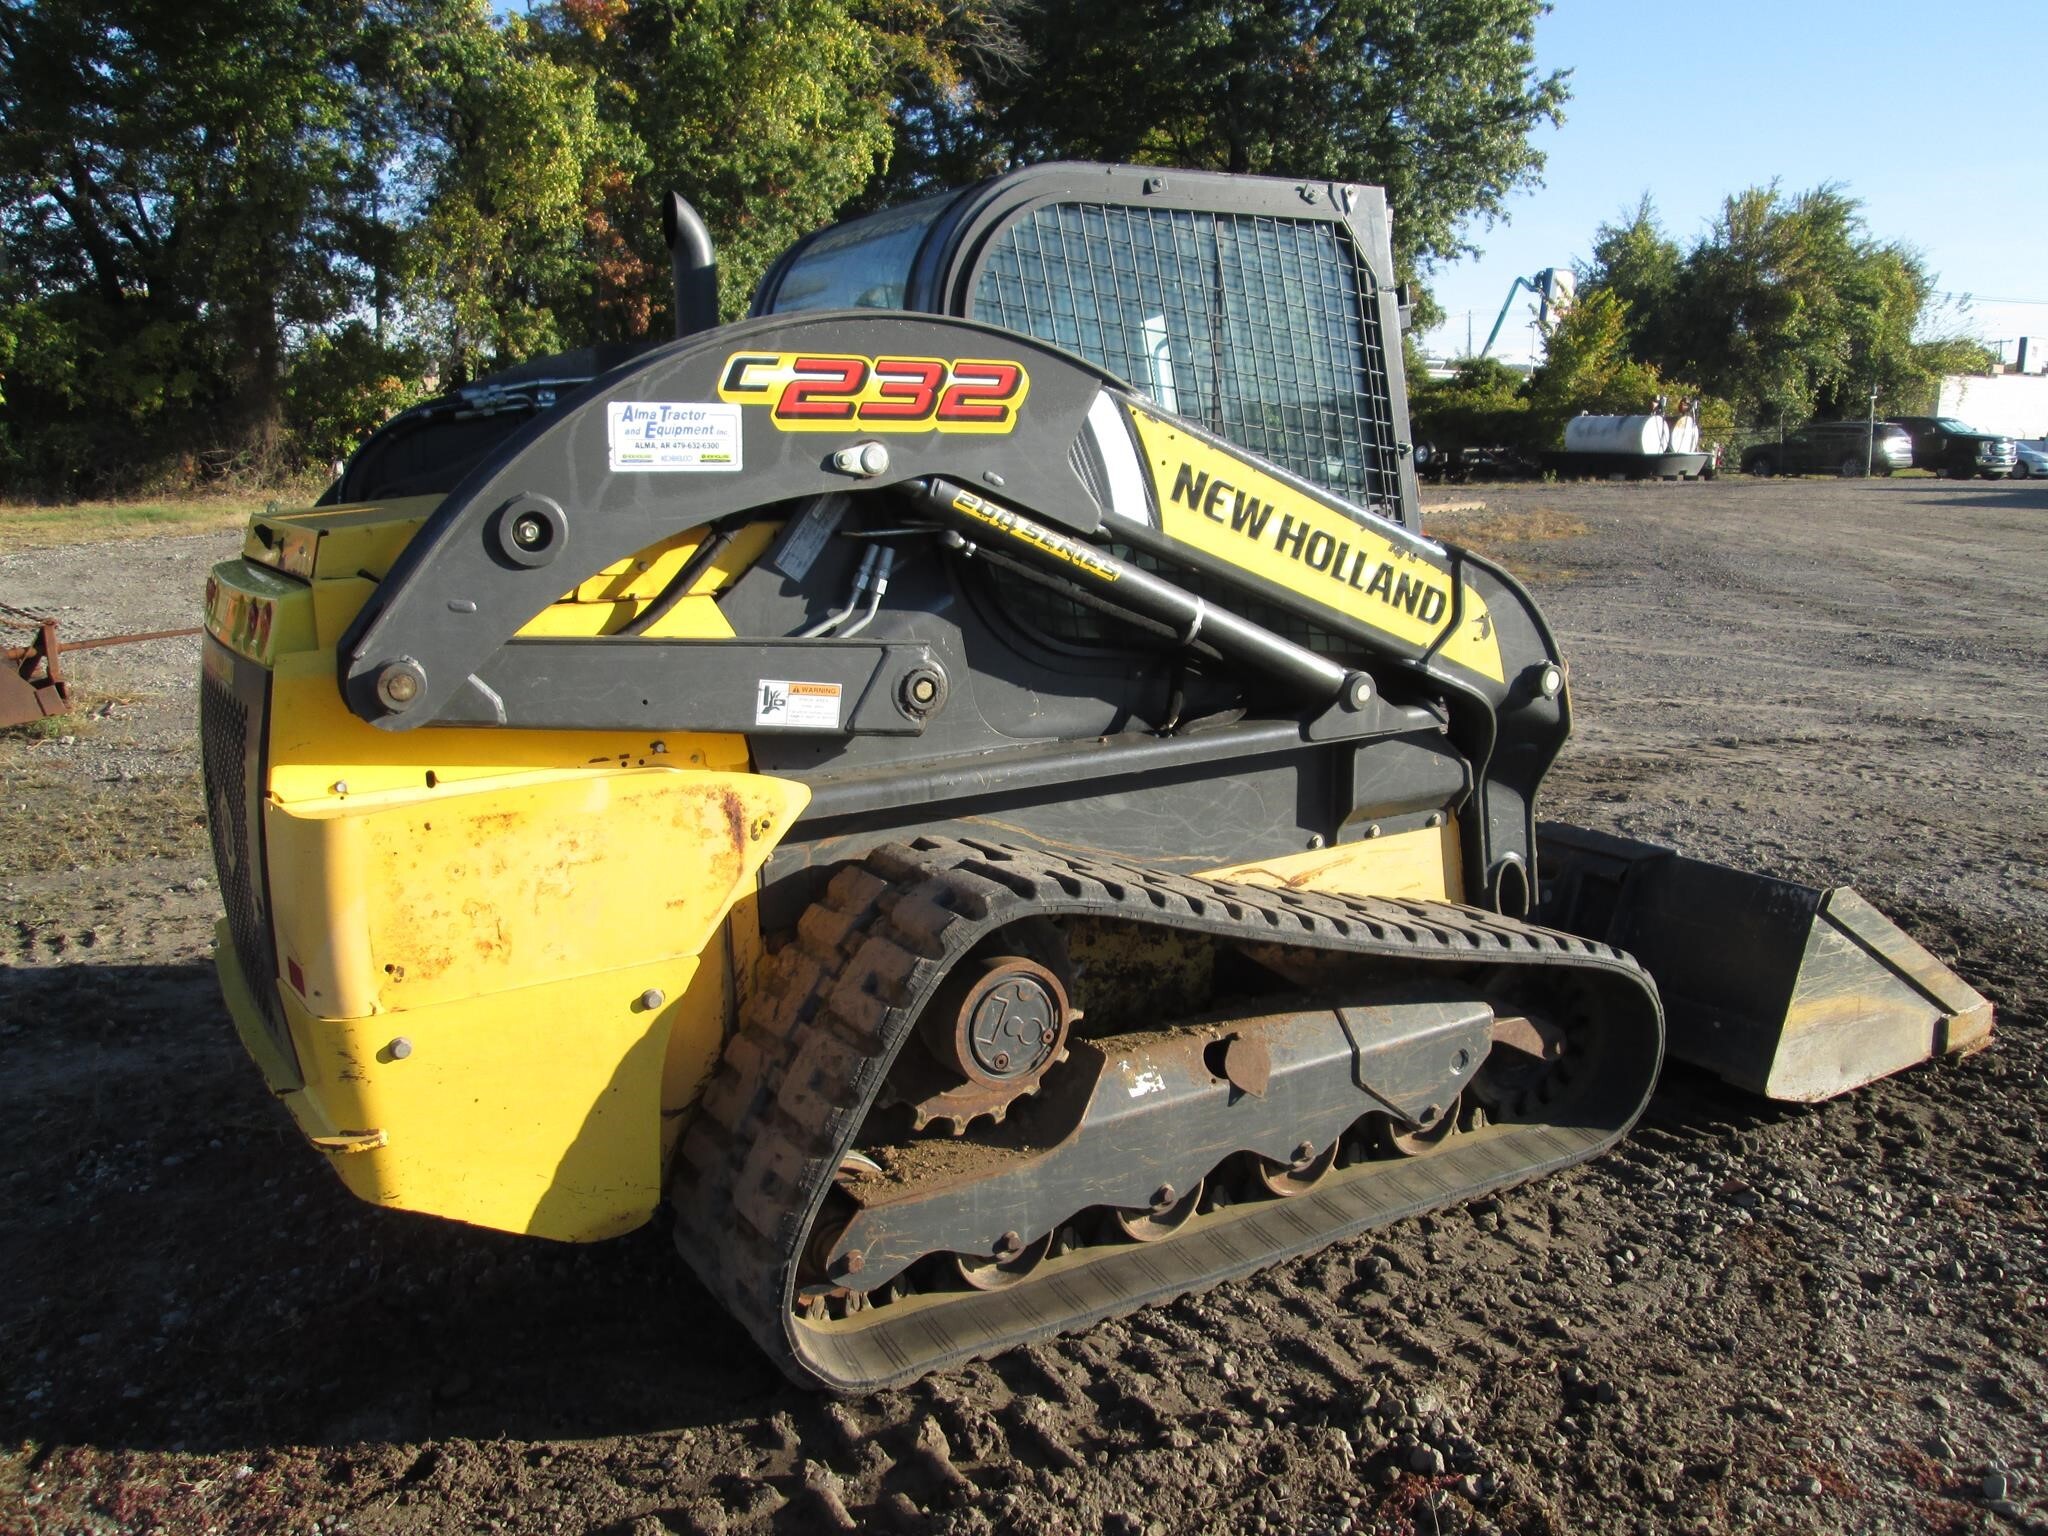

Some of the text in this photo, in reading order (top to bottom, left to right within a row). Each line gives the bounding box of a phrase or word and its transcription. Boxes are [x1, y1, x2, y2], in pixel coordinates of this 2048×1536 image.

[622, 405, 707, 422] Alma Tractor
[645, 421, 714, 438] Equipment
[1169, 461, 1448, 626] NEW HOLLAND
[801, 686, 837, 695] WARNING
